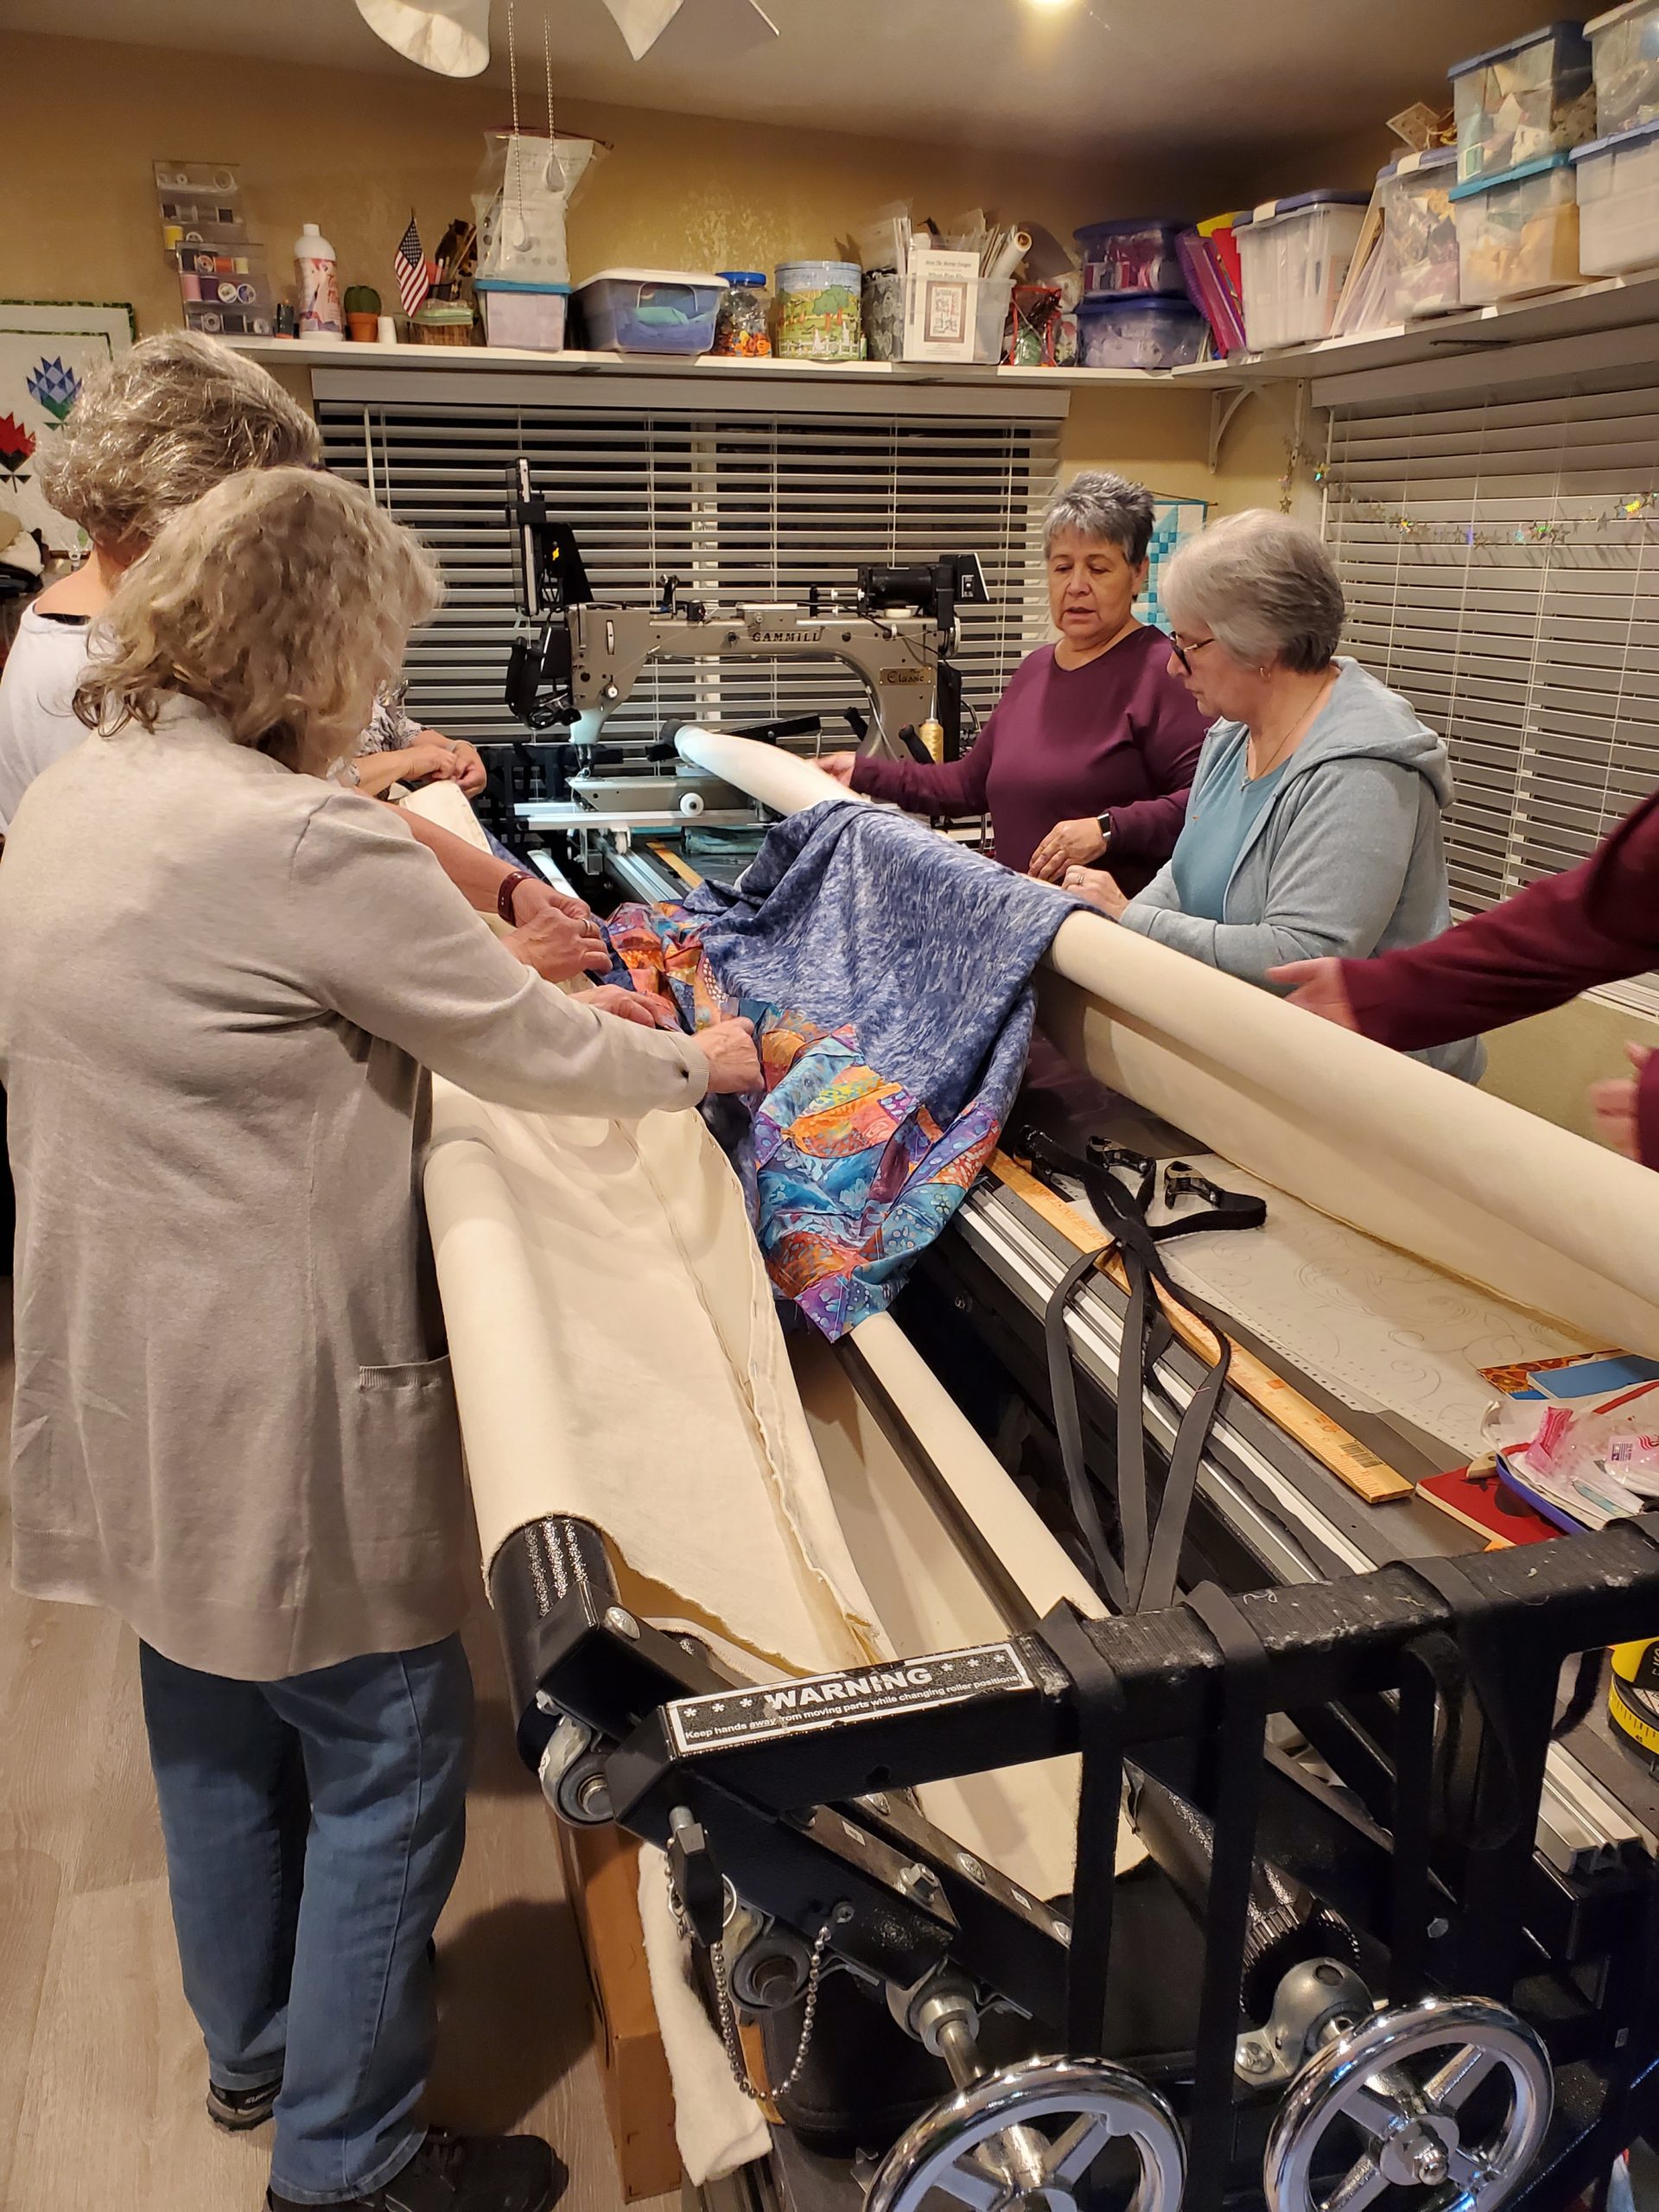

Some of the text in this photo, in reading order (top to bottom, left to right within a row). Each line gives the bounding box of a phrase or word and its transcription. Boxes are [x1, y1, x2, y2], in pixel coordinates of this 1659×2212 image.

[753, 632, 821, 642] GAMMILL
[887, 671, 925, 683] Classic
[764, 1668, 933, 1710] WARNING
[685, 1729, 713, 1740] Keep
[715, 1723, 747, 1735] hands
[749, 1718, 777, 1729] away
[804, 1706, 842, 1719] moving
[843, 1700, 869, 1713] parts
[870, 1695, 898, 1709] while
[899, 1686, 945, 1703] changing
[946, 1682, 972, 1694] roller
